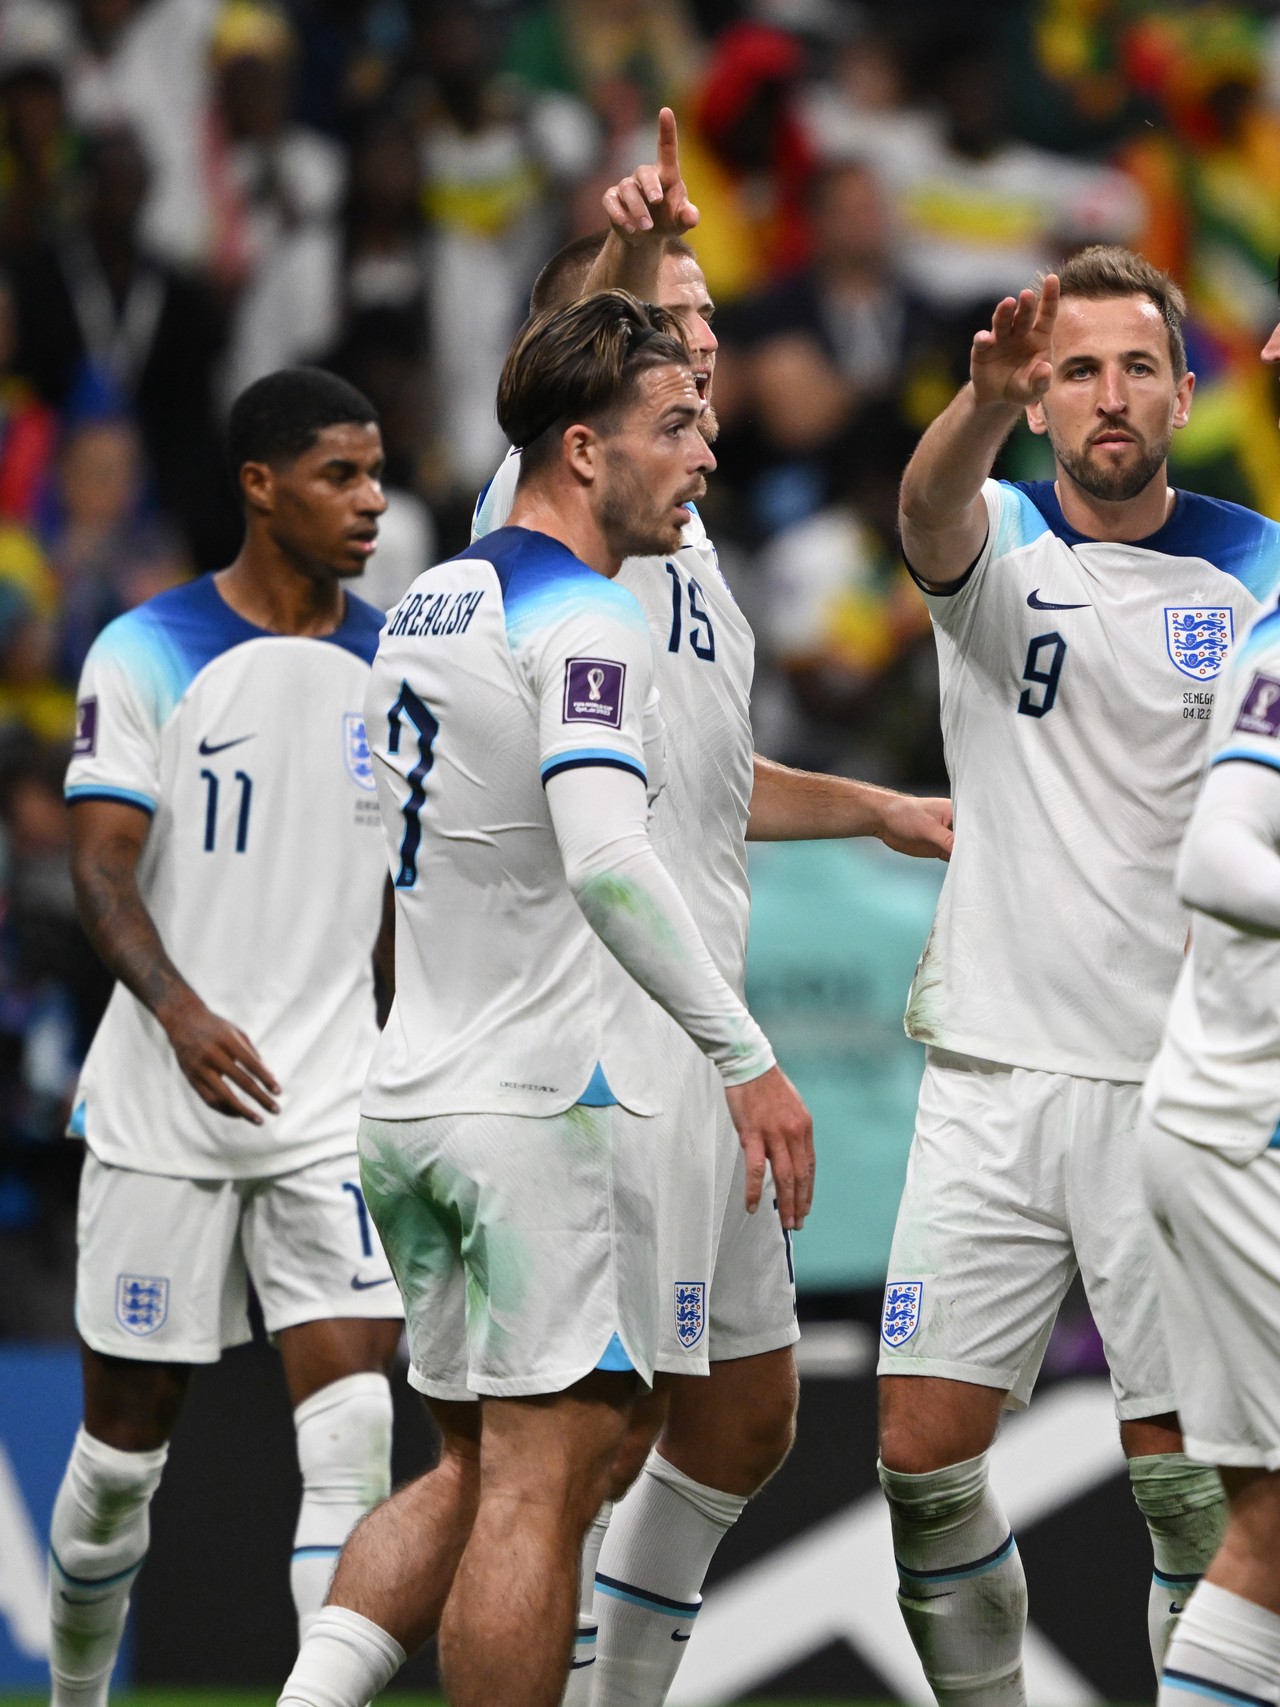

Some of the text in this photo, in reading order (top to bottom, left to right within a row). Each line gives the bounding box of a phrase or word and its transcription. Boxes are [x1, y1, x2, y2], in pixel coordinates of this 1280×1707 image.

[386, 590, 485, 637] GREALISH
[664, 561, 716, 663] 15
[1017, 631, 1067, 719] 9
[1182, 692, 1216, 706] SENEGA
[1182, 707, 1212, 720] 04.12.2
[200, 768, 253, 854] 11
[387, 677, 440, 890] 7
